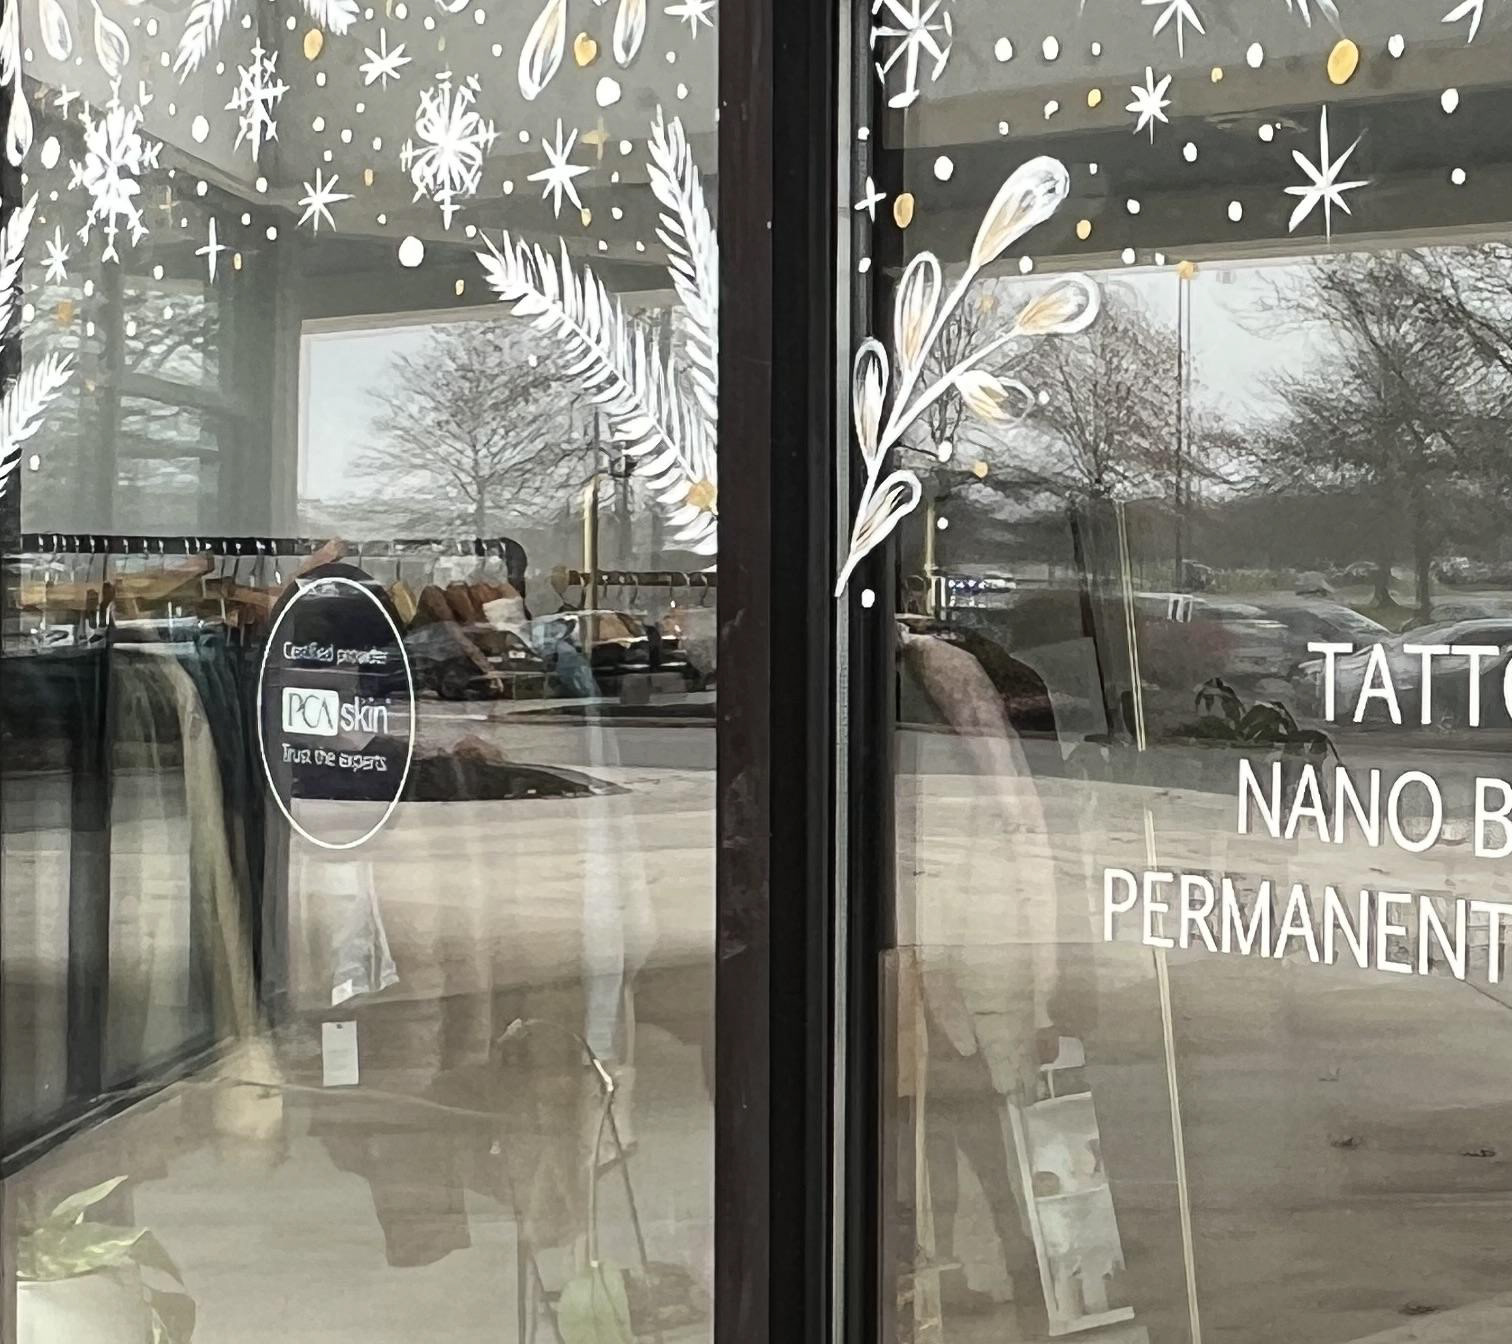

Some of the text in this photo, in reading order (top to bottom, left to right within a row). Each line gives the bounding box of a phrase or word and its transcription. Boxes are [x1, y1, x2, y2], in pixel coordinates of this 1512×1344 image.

[288, 692, 389, 735] PCA skin
[1237, 758, 1443, 854] NANO
